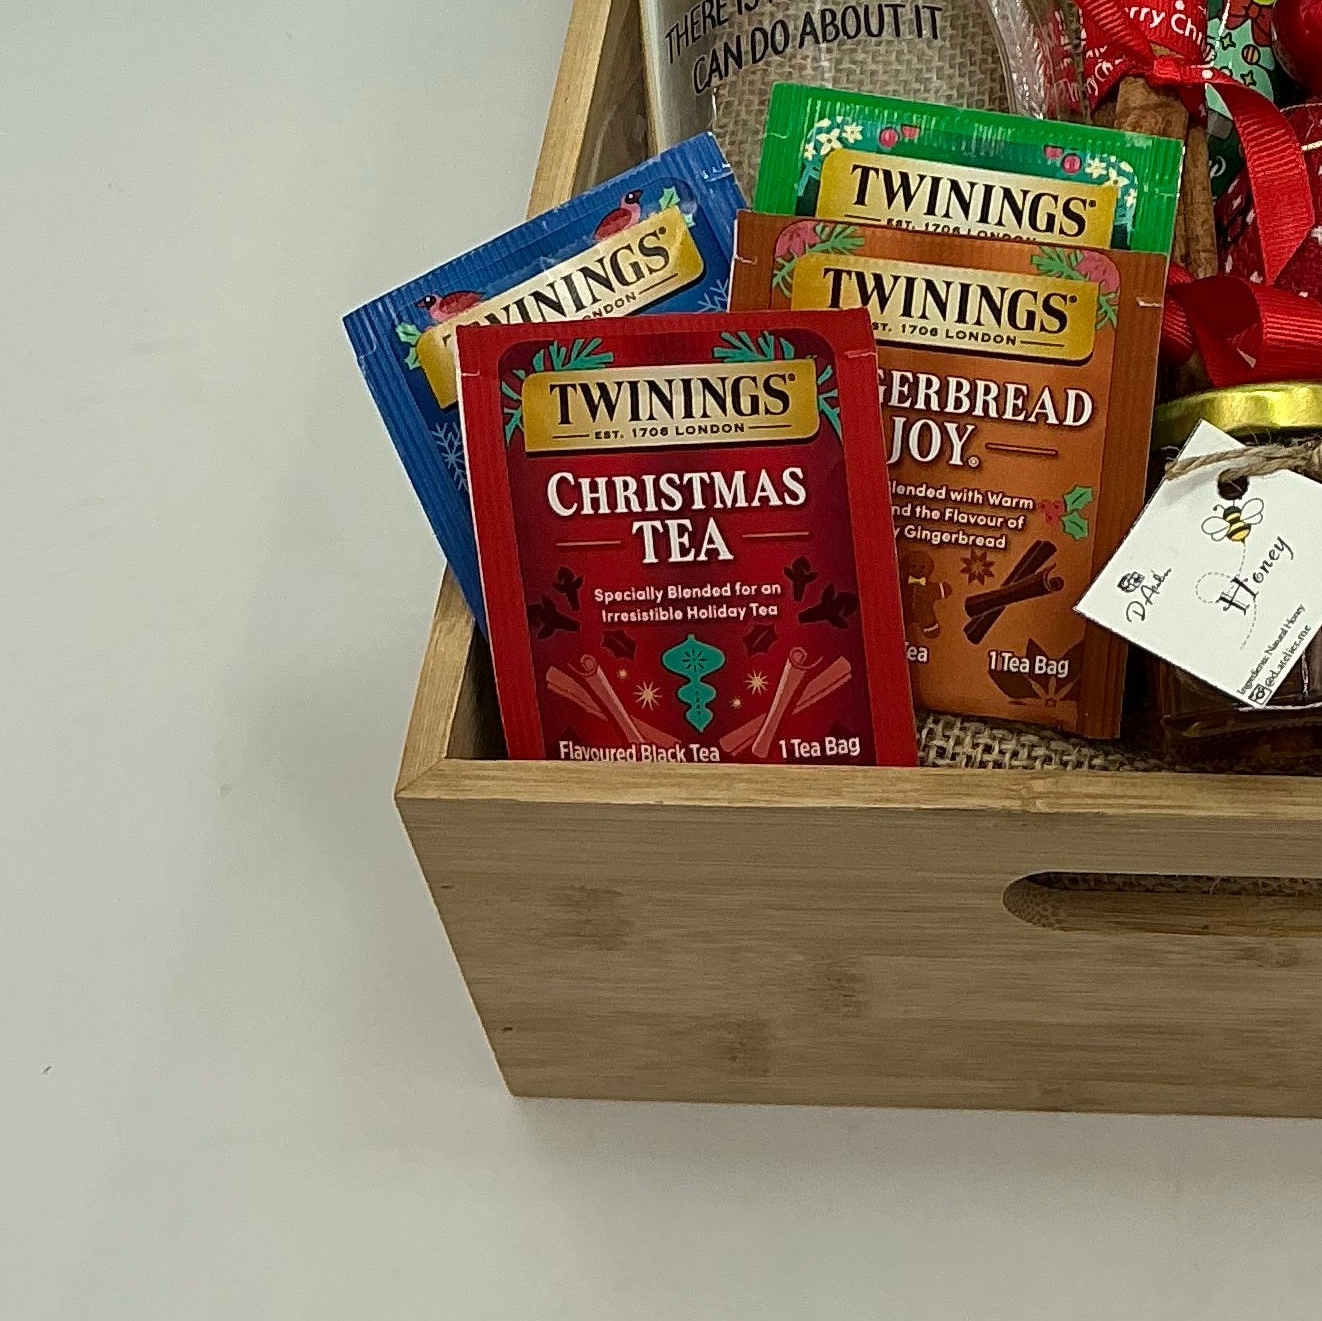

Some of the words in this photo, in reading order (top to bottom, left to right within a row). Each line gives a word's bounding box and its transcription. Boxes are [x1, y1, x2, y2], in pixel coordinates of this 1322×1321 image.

[692, 34, 743, 95] CAN
[750, 18, 790, 66] DO
[798, 2, 906, 50] ABOUT
[913, 4, 943, 40] IT
[470, 229, 671, 328] ININGS
[872, 321, 893, 334] ST.
[945, 326, 1017, 347] LONDON
[877, 368, 1093, 427] ERBREAD
[594, 428, 625, 441] EST.
[674, 422, 745, 438] LONDON
[546, 466, 807, 518] CHRISTMAS
[890, 482, 947, 501] lended
[950, 487, 984, 505] with
[987, 491, 1034, 510] Warm
[890, 503, 913, 519] nd
[915, 505, 941, 521] the
[944, 509, 1005, 528] Flavour
[1007, 515, 1025, 530] of
[631, 517, 734, 565] TEA
[904, 524, 1008, 550] Gingerbread
[1216, 535, 1295, 616] Honey
[594, 584, 665, 605] Specially
[667, 582, 732, 601] Blended
[734, 581, 759, 597] for
[761, 582, 782, 596] an
[601, 607, 683, 624] Irresistible
[686, 604, 747, 623] Holiday
[749, 603, 778, 619] Tea
[903, 640, 928, 663] ea
[988, 649, 998, 671] 1
[1000, 652, 1031, 674] Tea
[1034, 656, 1069, 678] Bag
[558, 739, 636, 762] Flavoured
[641, 743, 687, 763] Black
[689, 742, 721, 763] Tea
[778, 739, 788, 760] 1
[790, 738, 822, 759] Tea
[825, 736, 861, 759] Bag
